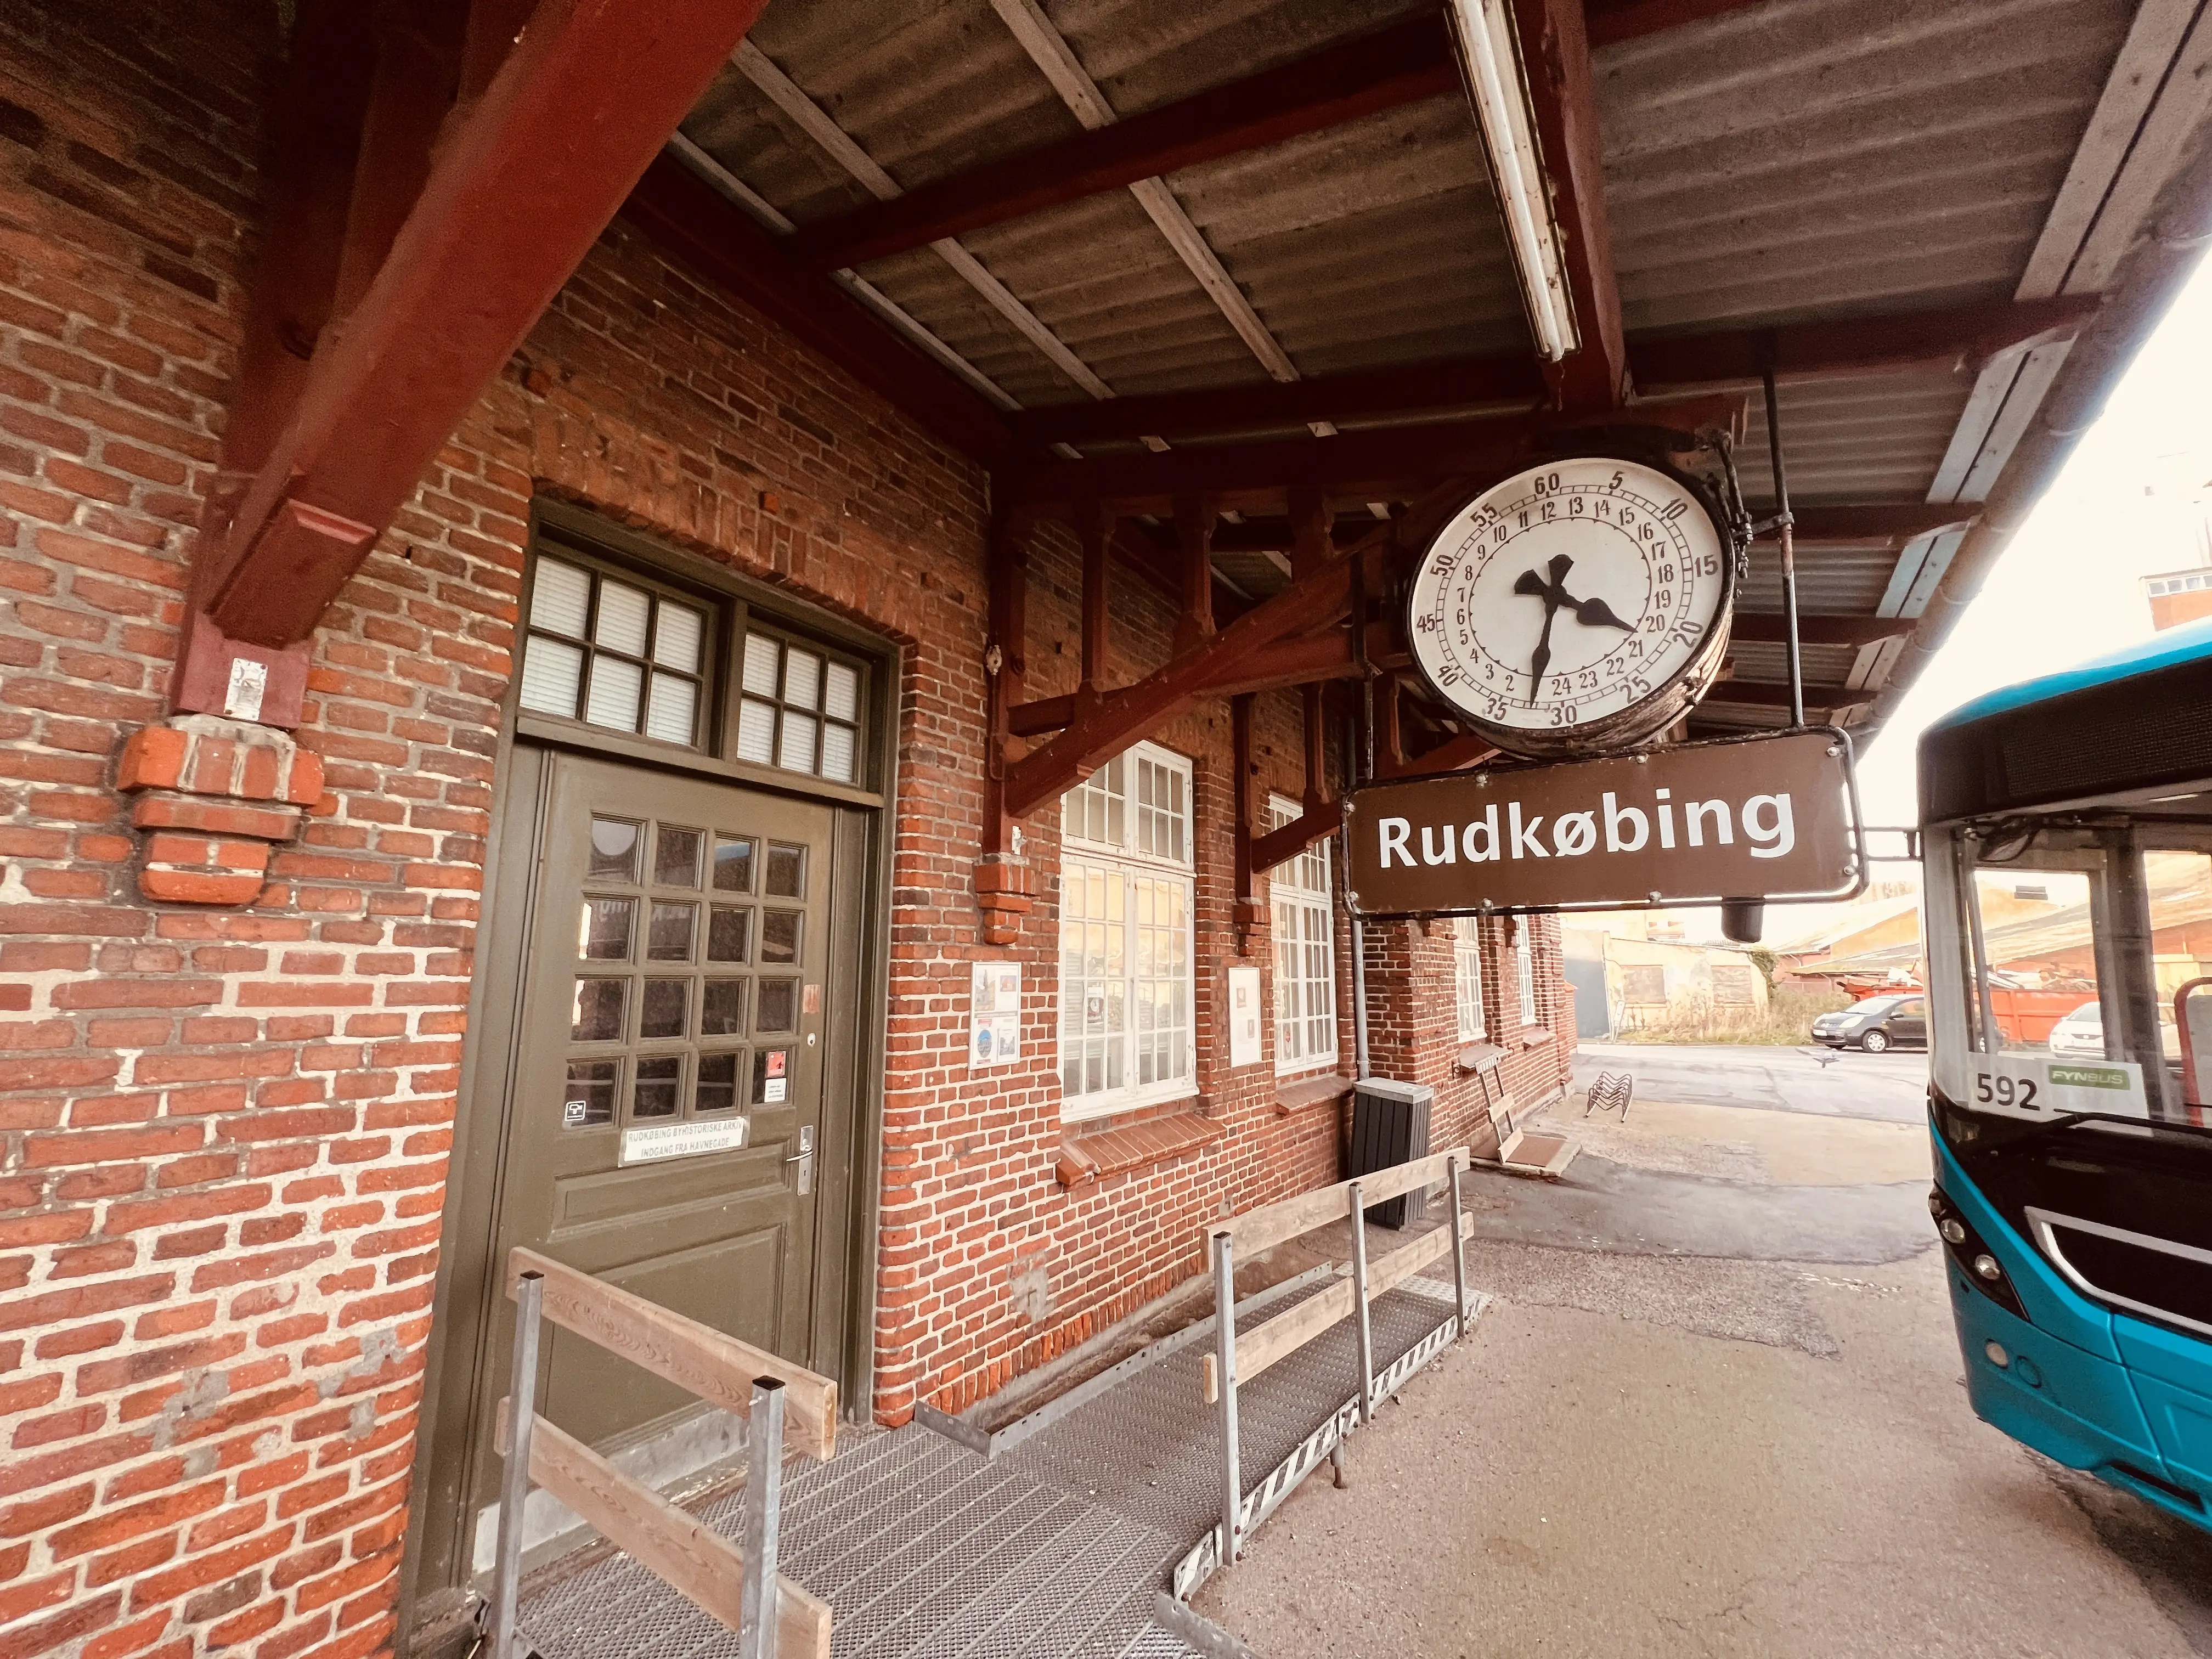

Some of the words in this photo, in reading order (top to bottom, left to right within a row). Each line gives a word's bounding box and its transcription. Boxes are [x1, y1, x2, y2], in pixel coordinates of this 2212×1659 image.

[1534, 472, 1560, 495] 60
[1609, 471, 1626, 490] 5
[1541, 503, 1557, 519] 12
[1569, 496, 1584, 514] 13
[1594, 499, 1611, 517] 14
[1661, 497, 1688, 521] 10
[1470, 503, 1499, 527] 55
[1518, 511, 1530, 528] 11
[1619, 509, 1635, 526] 15
[1493, 525, 1506, 543] 10
[1638, 523, 1653, 540] 16
[1477, 545, 1486, 560] 9
[1651, 541, 1667, 560] 17
[1430, 554, 1454, 577] 50
[1464, 565, 1473, 581] 8
[1658, 566, 1674, 583] 18
[1696, 554, 1719, 578] 15
[1457, 588, 1465, 602] 7
[1654, 590, 1671, 608] 19
[1416, 614, 1435, 633] 45
[1456, 609, 1465, 624] 6
[1646, 615, 1666, 633] 20
[1459, 629, 1468, 645] 5
[1673, 620, 1704, 648] 20
[1470, 649, 1480, 664] 4
[1629, 640, 1644, 658] 21
[1439, 664, 1460, 686] 40
[1485, 664, 1495, 680] 3
[1606, 657, 1626, 676] 22
[1505, 676, 1515, 692] 2
[1551, 678, 1572, 696] 24
[1579, 670, 1598, 689] 23
[1620, 676, 1651, 702] 25
[1486, 697, 1507, 721] 35
[1551, 705, 1577, 725] 30
[1378, 787, 1796, 869] Rudkøbing
[2052, 1070, 2123, 1085] FYNBUS
[1977, 1073, 2040, 1111] 592
[628, 1128, 672, 1143] RUDKØBING
[641, 1145, 673, 1158] INDGANG
[675, 1143, 687, 1153] FRA
[690, 1137, 730, 1151] HAVNEGADE
